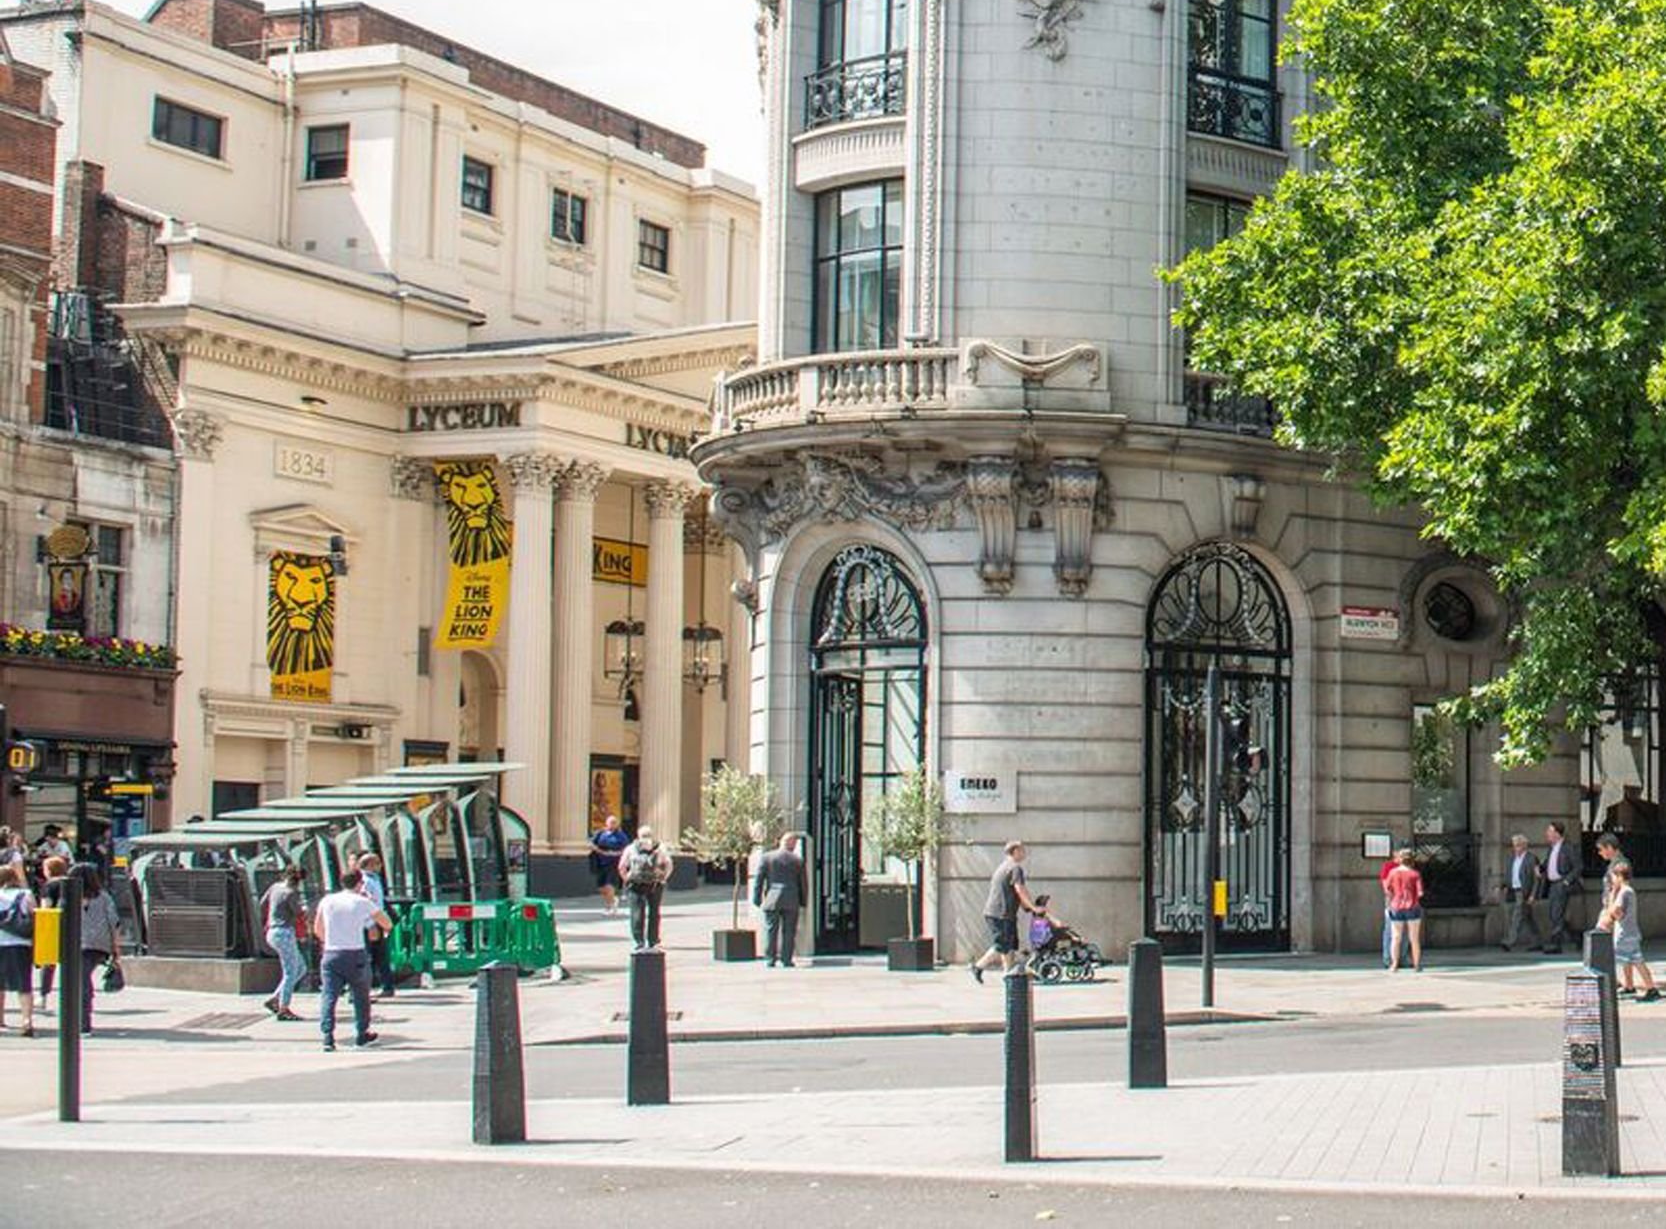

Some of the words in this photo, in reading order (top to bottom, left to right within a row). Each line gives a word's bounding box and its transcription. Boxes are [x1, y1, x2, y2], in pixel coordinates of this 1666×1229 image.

[408, 402, 520, 431] LYCEUM
[281, 450, 325, 478] 1834
[463, 585, 491, 600] THE
[455, 604, 494, 618] LION
[449, 622, 489, 637] KING
